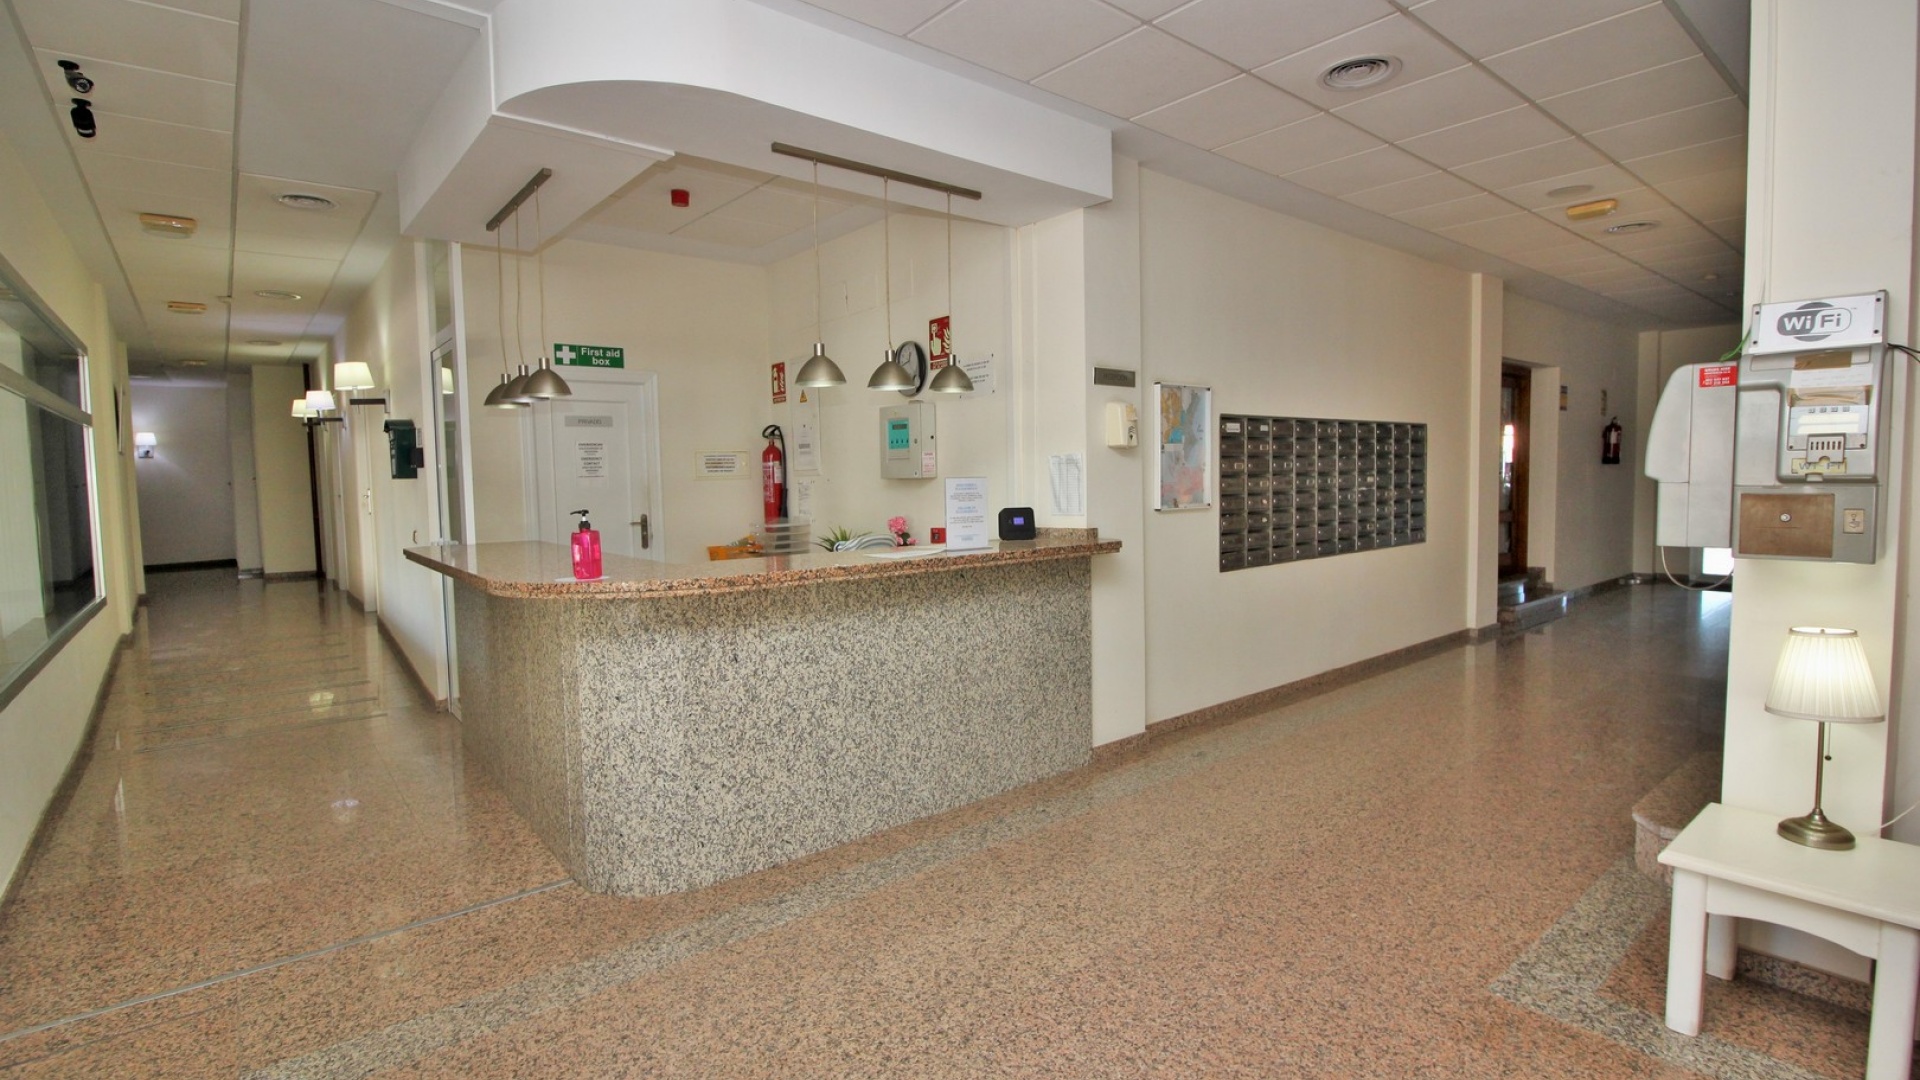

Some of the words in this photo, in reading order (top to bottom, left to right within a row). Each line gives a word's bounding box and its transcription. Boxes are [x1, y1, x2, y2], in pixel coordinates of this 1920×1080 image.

[581, 347, 604, 356] First
[606, 349, 620, 357] aid
[592, 357, 610, 366] box
